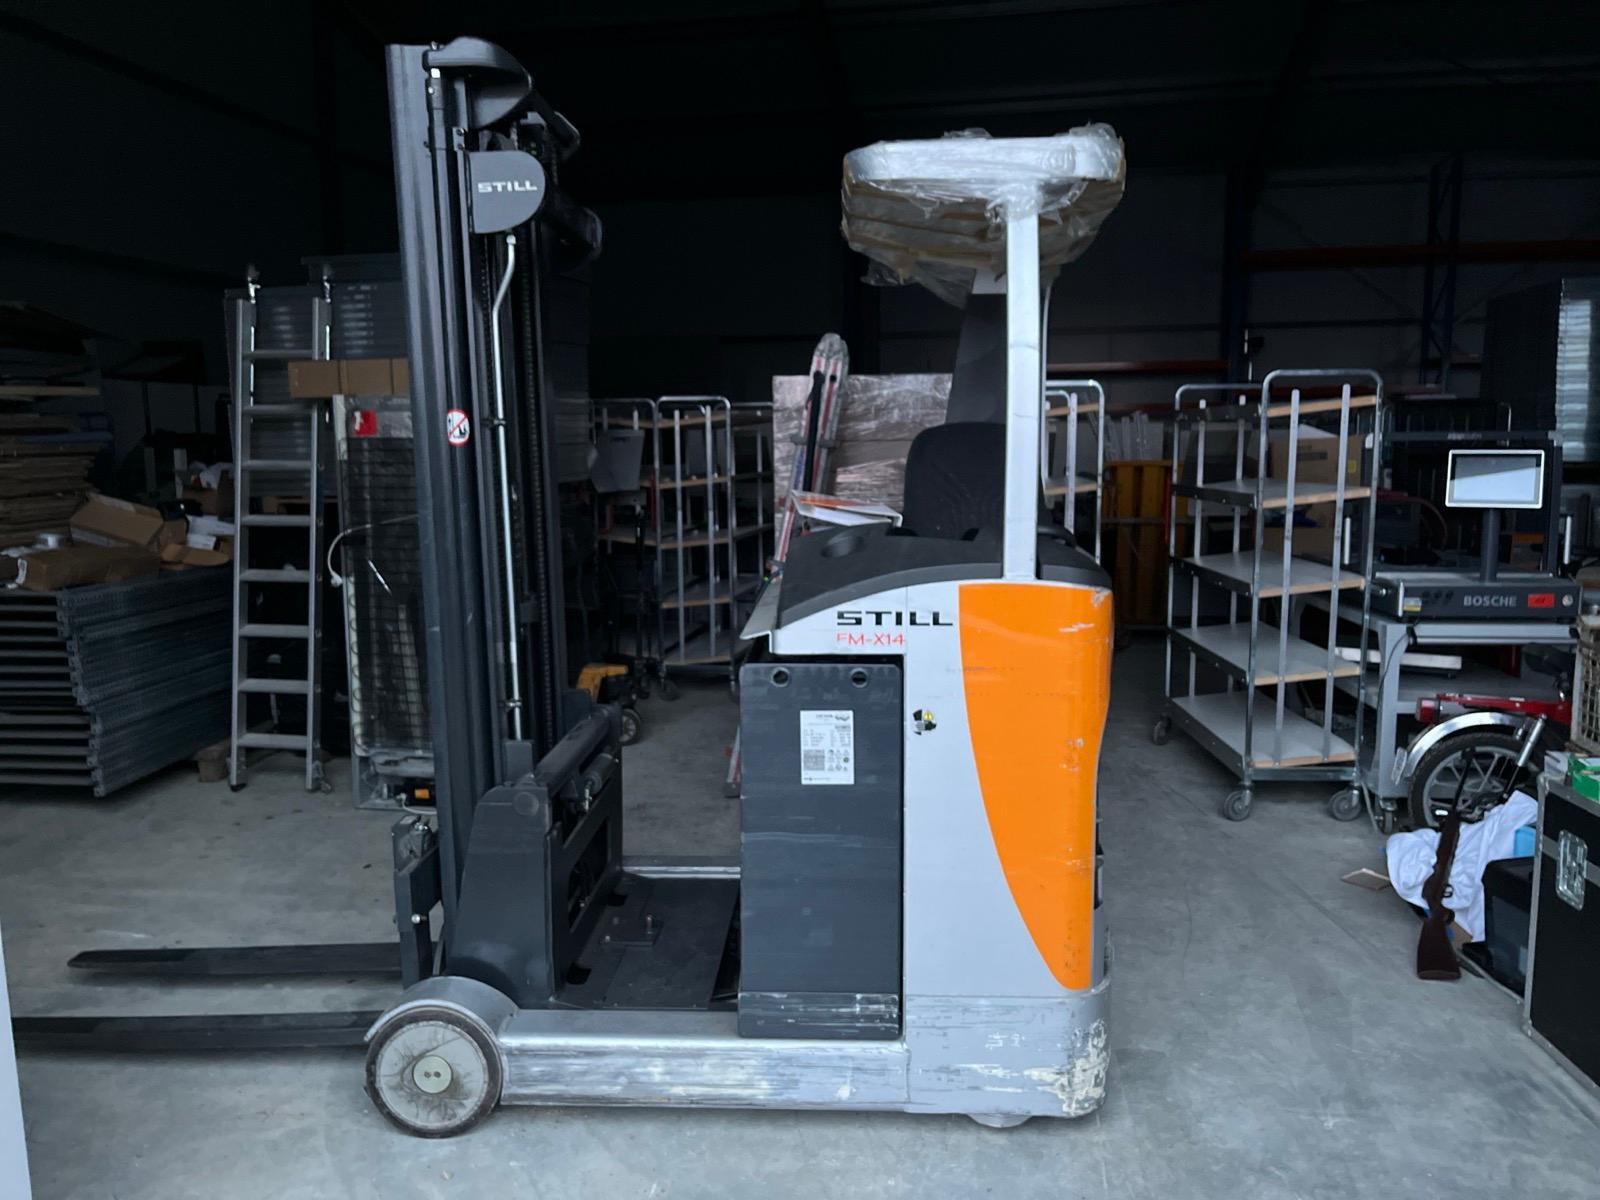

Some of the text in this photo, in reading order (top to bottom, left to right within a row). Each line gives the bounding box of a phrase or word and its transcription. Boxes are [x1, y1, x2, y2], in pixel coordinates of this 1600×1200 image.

[477, 180, 538, 193] STILL
[1463, 595, 1517, 607] BOSCHE
[837, 611, 953, 626] STILL
[836, 632, 905, 645] FM-X14
